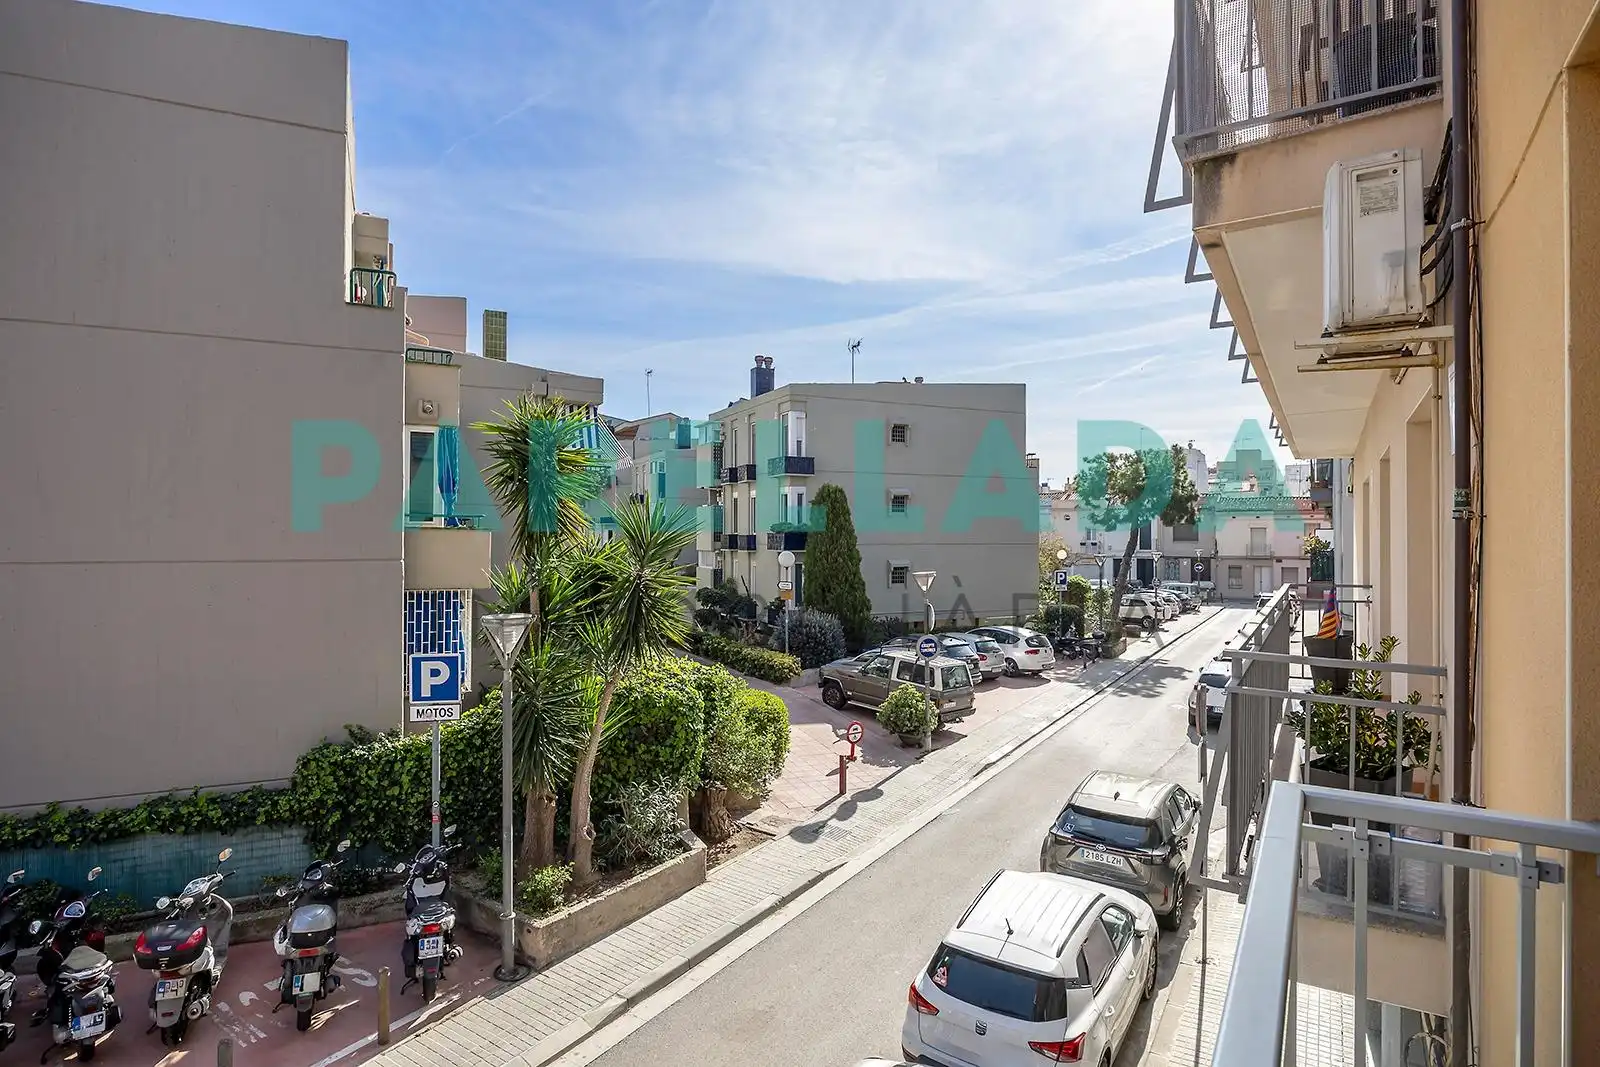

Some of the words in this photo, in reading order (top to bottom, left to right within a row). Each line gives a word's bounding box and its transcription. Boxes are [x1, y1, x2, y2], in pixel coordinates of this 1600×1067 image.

[1057, 572, 1066, 584] P
[421, 661, 450, 697] P
[416, 707, 454, 719] MOTOS
[1106, 855, 1122, 866] LZH
